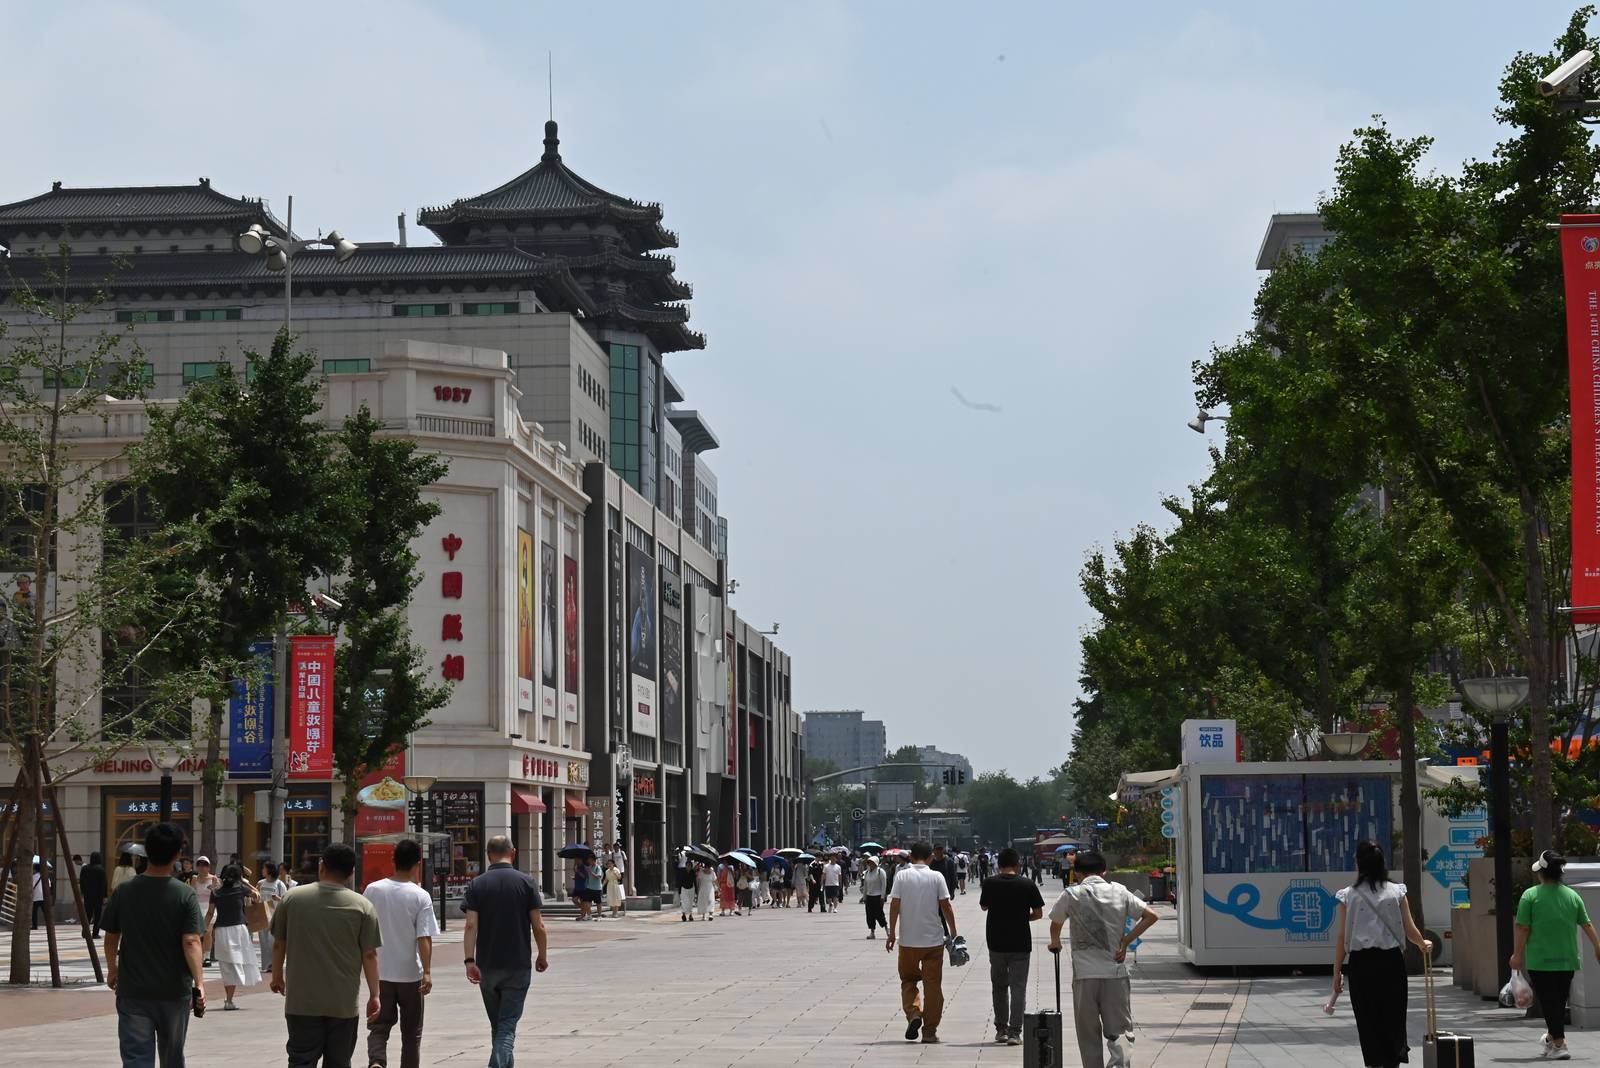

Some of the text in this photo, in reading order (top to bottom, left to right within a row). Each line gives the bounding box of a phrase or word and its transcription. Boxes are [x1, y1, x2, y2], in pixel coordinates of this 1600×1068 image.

[1591, 339, 1600, 371] CHINA
[1200, 734, 1223, 748] 饮品
[95, 759, 153, 773] BEIJING
[1290, 879, 1321, 888] BEIJING
